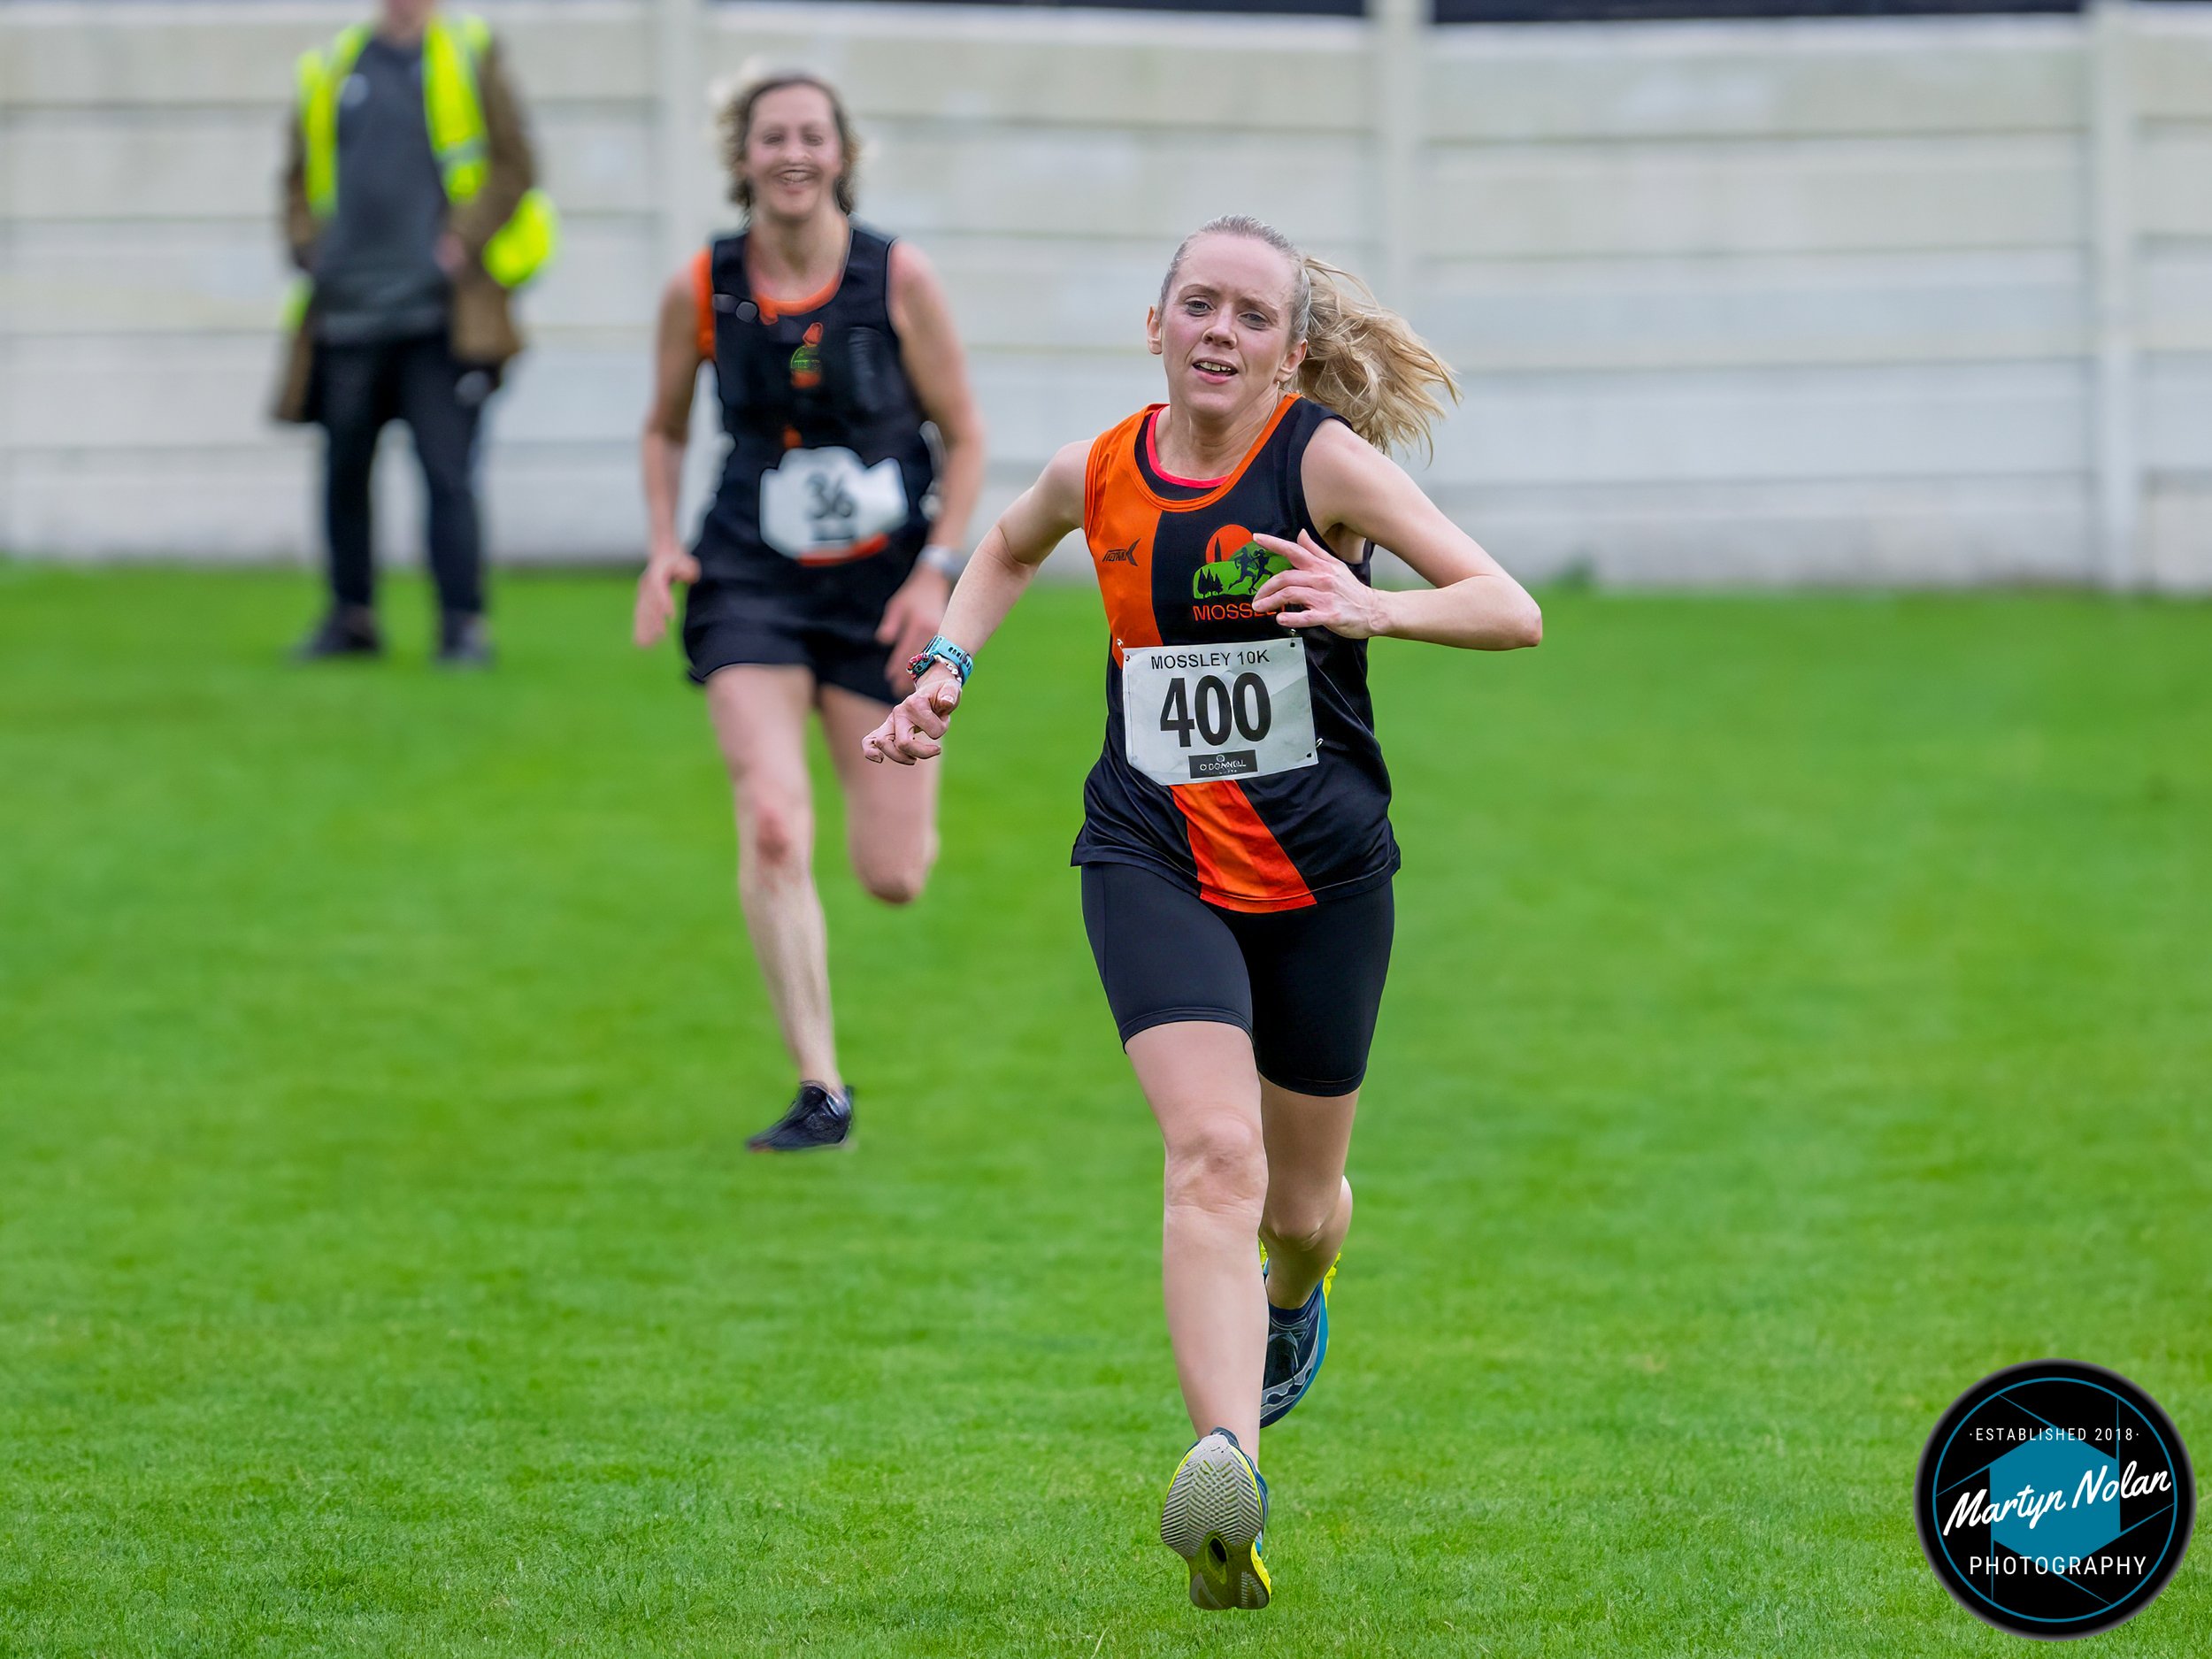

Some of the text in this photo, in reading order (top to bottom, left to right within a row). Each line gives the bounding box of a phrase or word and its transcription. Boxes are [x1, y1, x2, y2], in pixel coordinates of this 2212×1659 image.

[806, 472, 859, 518] 36
[1192, 603, 1286, 621] MOSS
[1150, 649, 1271, 670] MOSSLEY 10K
[1159, 672, 1272, 748] 400
